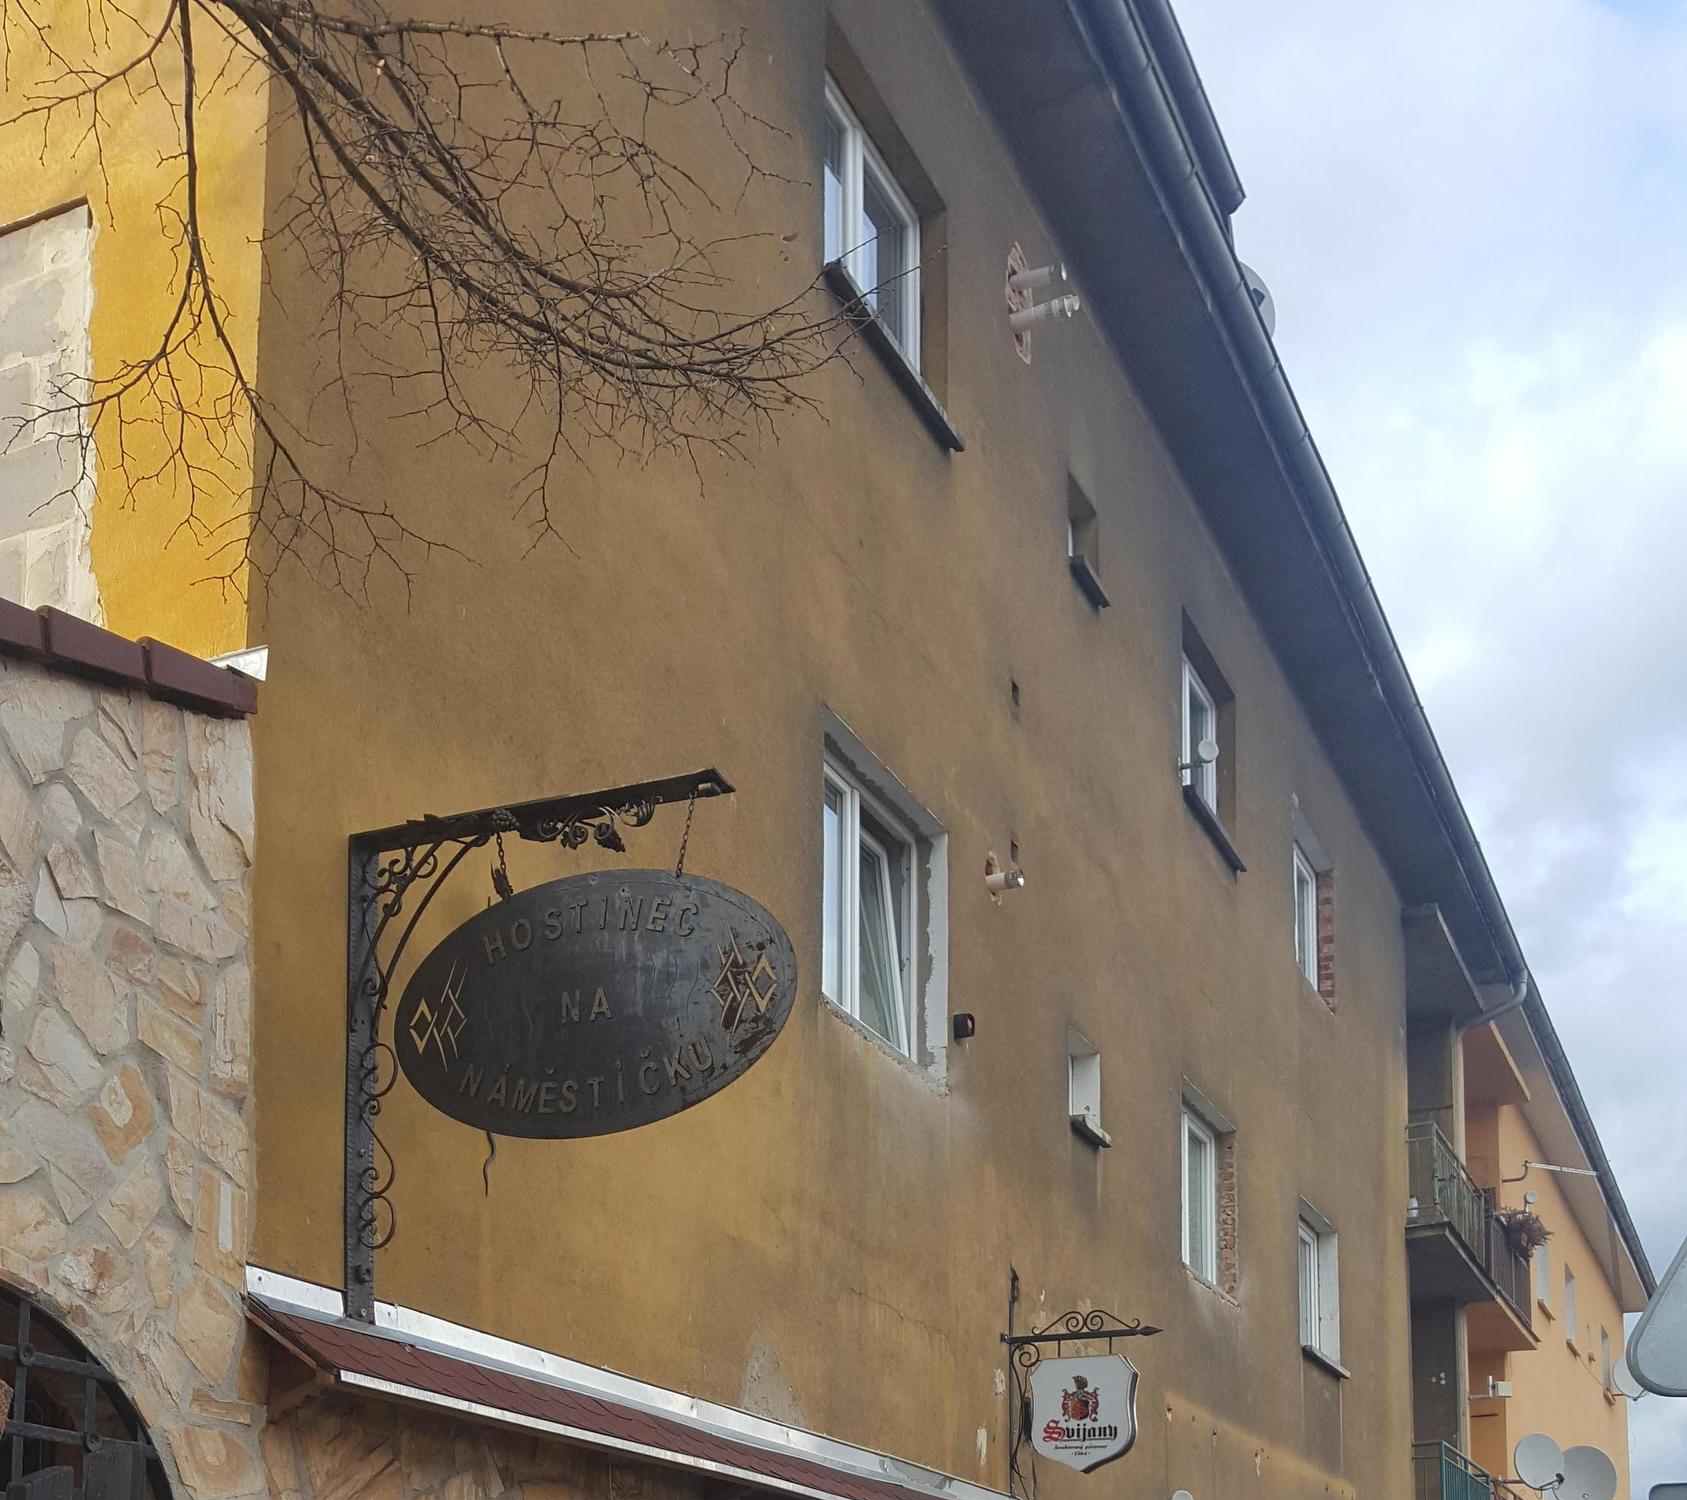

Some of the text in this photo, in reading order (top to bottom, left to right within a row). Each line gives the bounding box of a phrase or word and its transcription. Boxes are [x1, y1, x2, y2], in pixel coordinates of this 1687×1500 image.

[483, 896, 698, 965] HOSTINEC
[561, 986, 612, 1024] NA
[459, 1036, 715, 1114] NÁMĚSTÍČKU
[1043, 1419, 1117, 1442] Svijany
